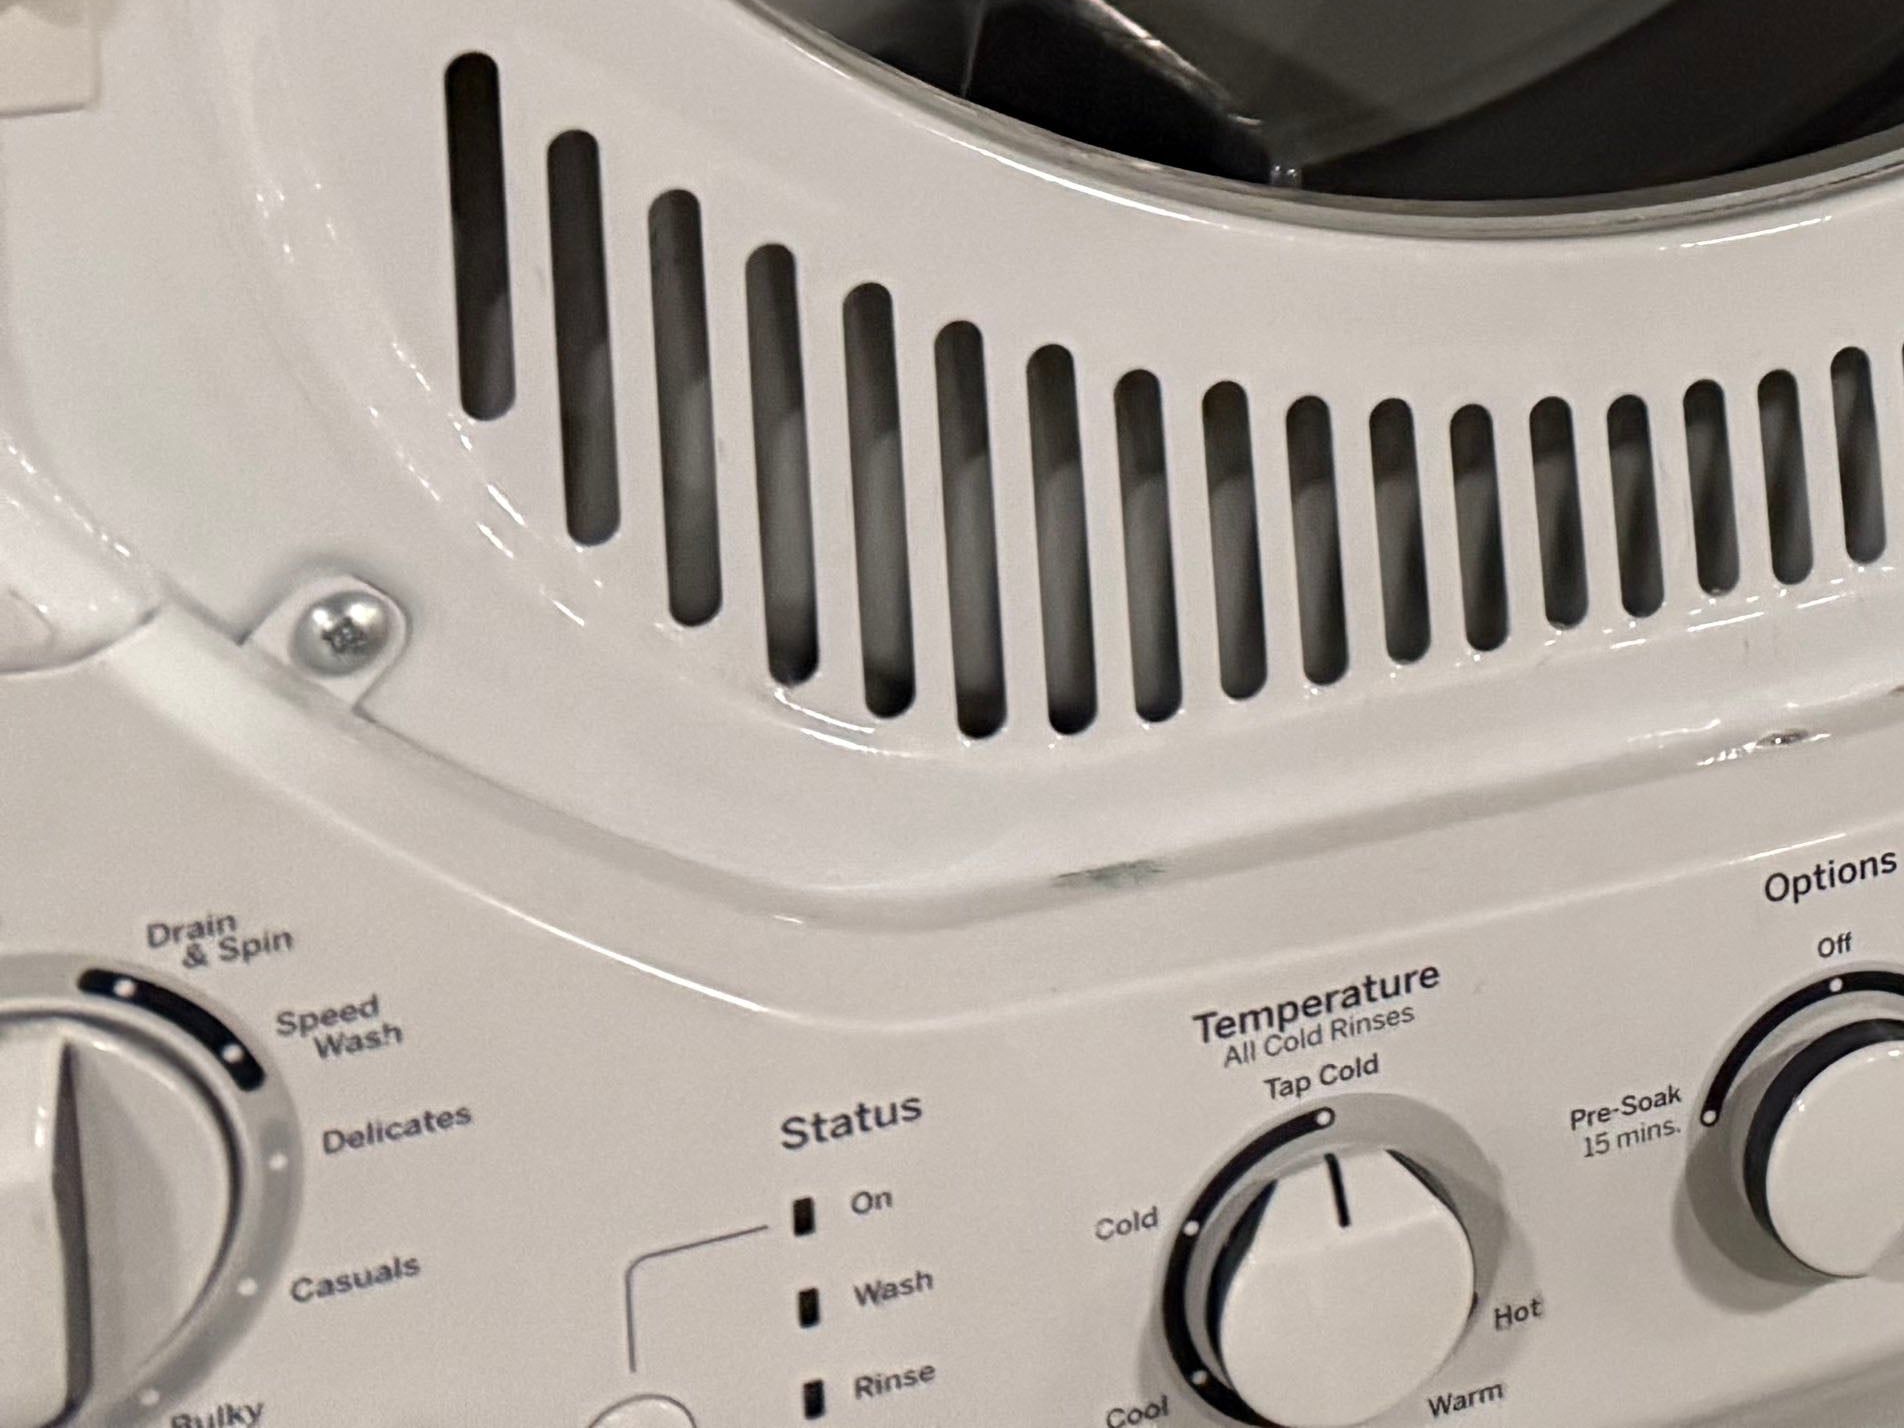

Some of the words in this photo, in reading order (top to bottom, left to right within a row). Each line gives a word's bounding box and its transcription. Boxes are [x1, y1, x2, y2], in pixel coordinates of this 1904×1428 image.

[1763, 847, 1898, 903] Options
[147, 913, 237, 949] Drain
[182, 945, 207, 969] &
[219, 929, 294, 964] Spin
[1817, 930, 1852, 958] Off
[276, 994, 379, 1038] Speed
[1192, 964, 1440, 1045] Temperature
[313, 1022, 403, 1061] Wash
[1223, 1033, 1257, 1068] All
[1264, 1021, 1324, 1058] Cold
[1330, 1005, 1415, 1042] Rinses
[1264, 1073, 1313, 1101] Tap
[1319, 1053, 1378, 1088] Cold
[781, 1096, 923, 1151] Status
[1569, 1082, 1683, 1132] Pre-Soak
[322, 1103, 473, 1156] Delicates
[1581, 1129, 1610, 1160] 15
[1615, 1116, 1681, 1150] mins.
[851, 1189, 893, 1216] On
[1095, 1206, 1158, 1242] Cold
[290, 1254, 421, 1304] Casuals
[853, 1270, 934, 1308] Wash
[1495, 1297, 1543, 1331] Hot
[854, 1362, 937, 1400] Rinse
[1428, 1381, 1504, 1419] Warm
[1106, 1395, 1169, 1428] Cool
